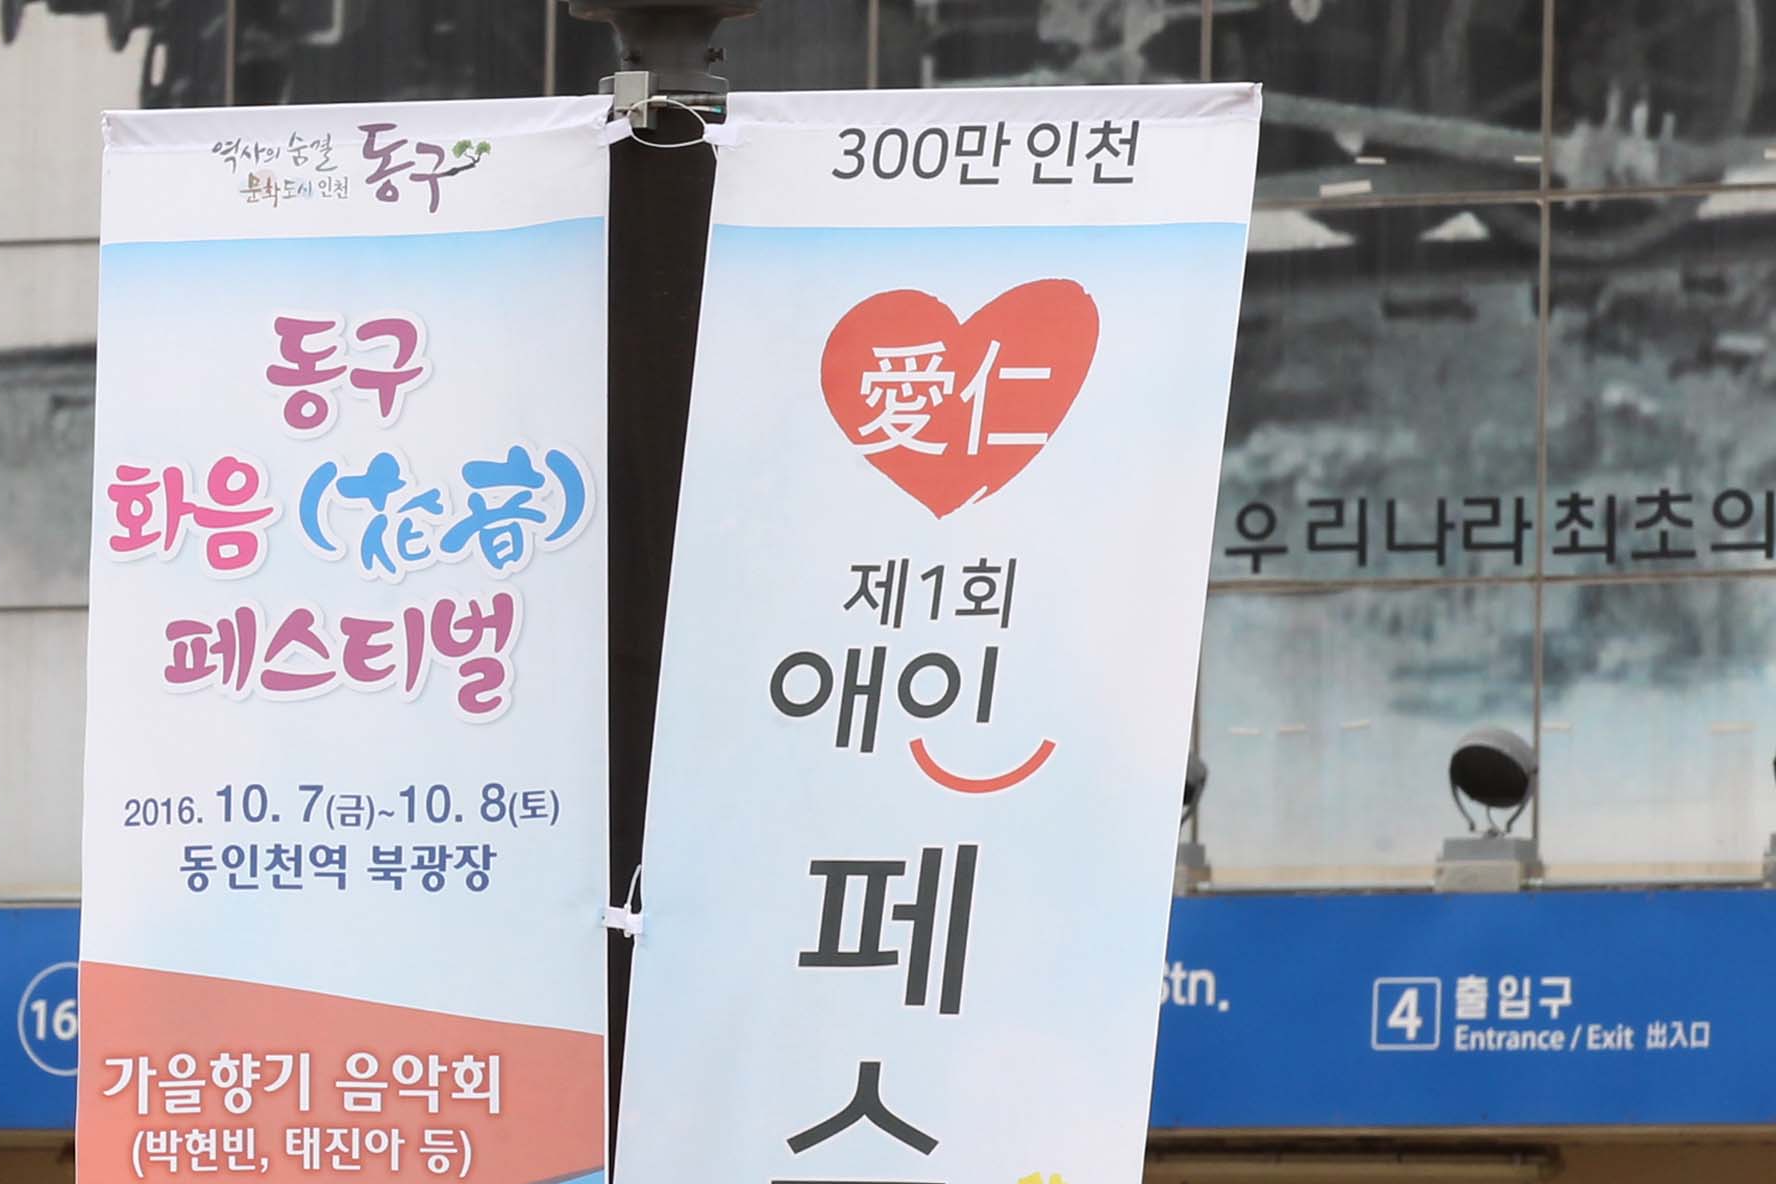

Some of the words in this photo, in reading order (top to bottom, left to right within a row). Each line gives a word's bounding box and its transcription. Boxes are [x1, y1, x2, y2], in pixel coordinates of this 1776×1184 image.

[212, 138, 280, 173] 역사의
[287, 131, 338, 172] 숨결
[358, 123, 446, 214] 동구
[831, 120, 1011, 185] 300만
[1027, 120, 1141, 185] 인천
[240, 172, 313, 208] 문화도시
[318, 176, 349, 199] 인천
[266, 316, 423, 430] 동구
[853, 338, 1053, 457] 愛仁
[107, 455, 274, 571] 화음
[843, 558, 1017, 629] 제1회
[164, 592, 515, 714] 페스티벌
[124, 796, 204, 827] 2016.
[179, 842, 347, 893] 동인천역
[367, 843, 497, 893] 북광장
[1386, 987, 1422, 1041] 4
[1455, 974, 1572, 1020] 출입구
[1454, 1024, 1565, 1051] Entrance
[1586, 1023, 1634, 1050] Exit
[1645, 1020, 1711, 1049] 出入口
[103, 1052, 311, 1116] 가을향기
[335, 1052, 502, 1115] 음악회
[131, 1127, 270, 1179] (박현빈,
[285, 1126, 405, 1172] 태진아
[420, 1128, 473, 1179] 등)
